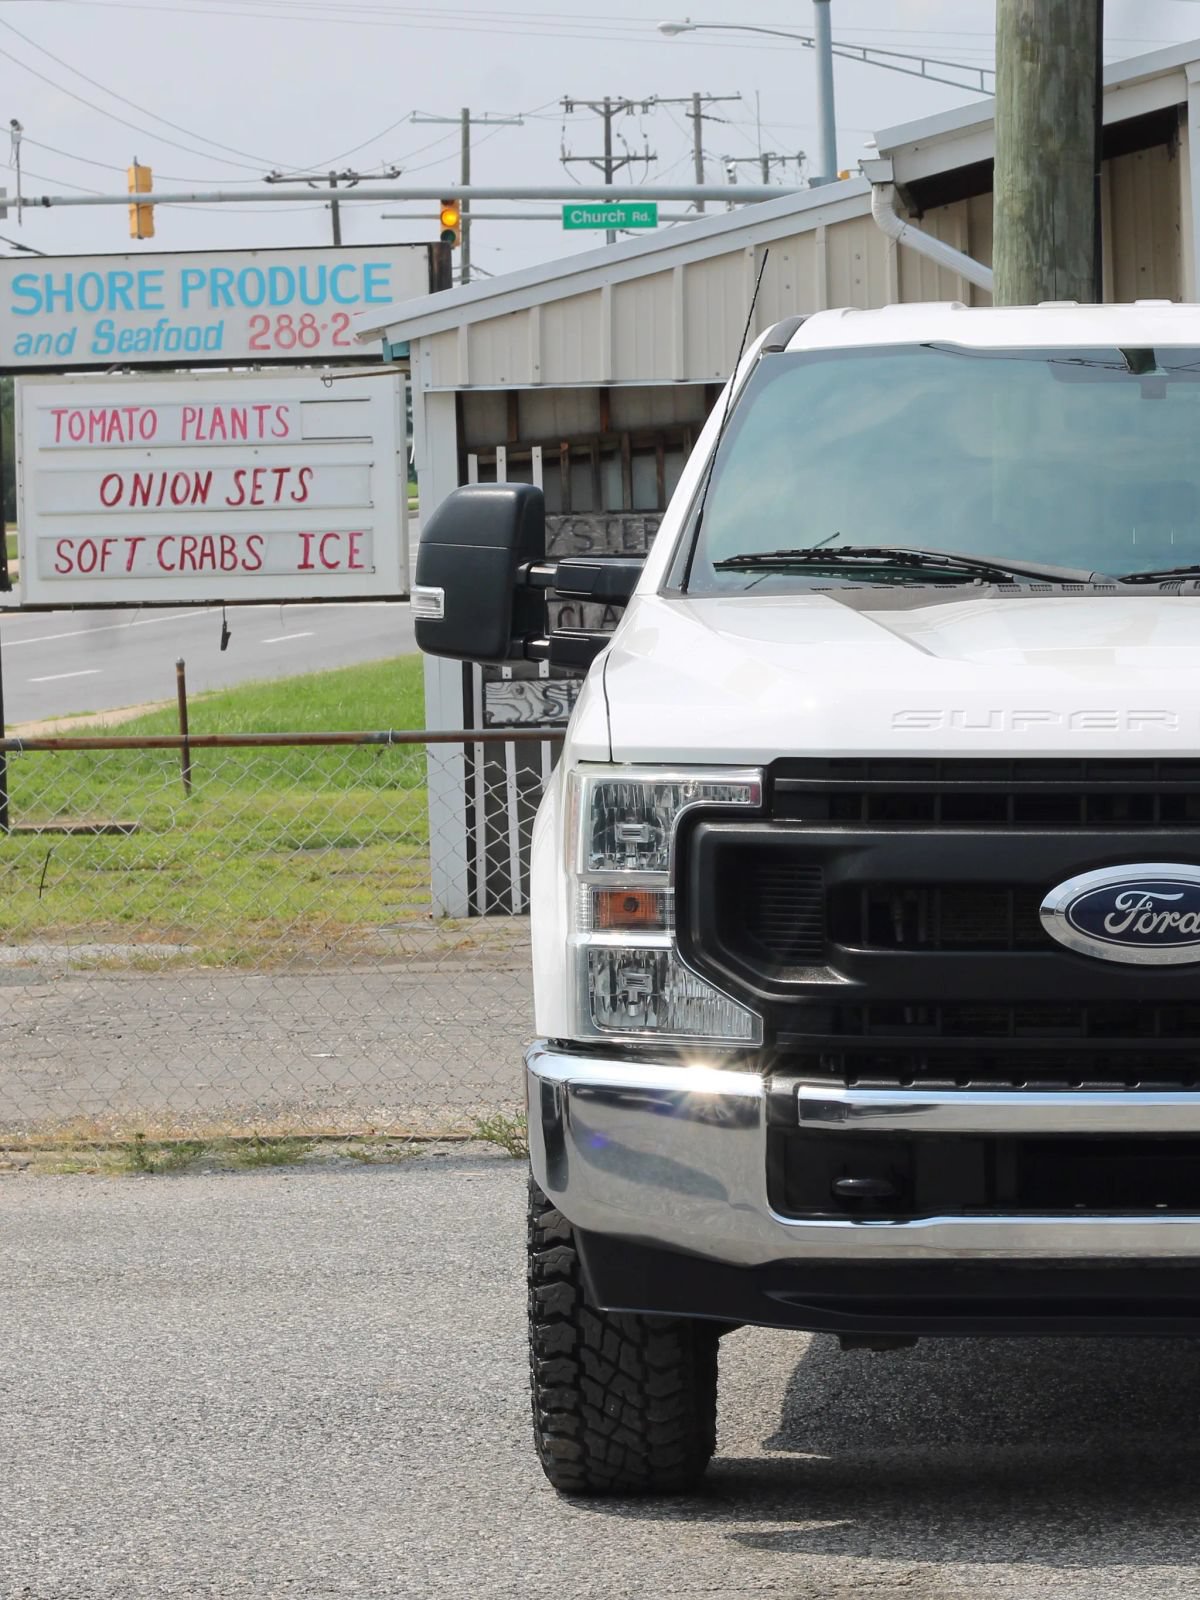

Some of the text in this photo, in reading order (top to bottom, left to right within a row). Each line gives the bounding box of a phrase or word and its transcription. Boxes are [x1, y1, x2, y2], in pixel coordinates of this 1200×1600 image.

[570, 209, 626, 224] Church
[10, 262, 393, 316] SHORE PRODUCE
[13, 326, 77, 357] and
[91, 318, 225, 356] Seafood
[50, 404, 290, 444] TOMATO PLANTS
[99, 466, 314, 508] ONION SETS
[54, 532, 365, 575] SOFT CRABS ICE
[891, 708, 1179, 732] SUPER
